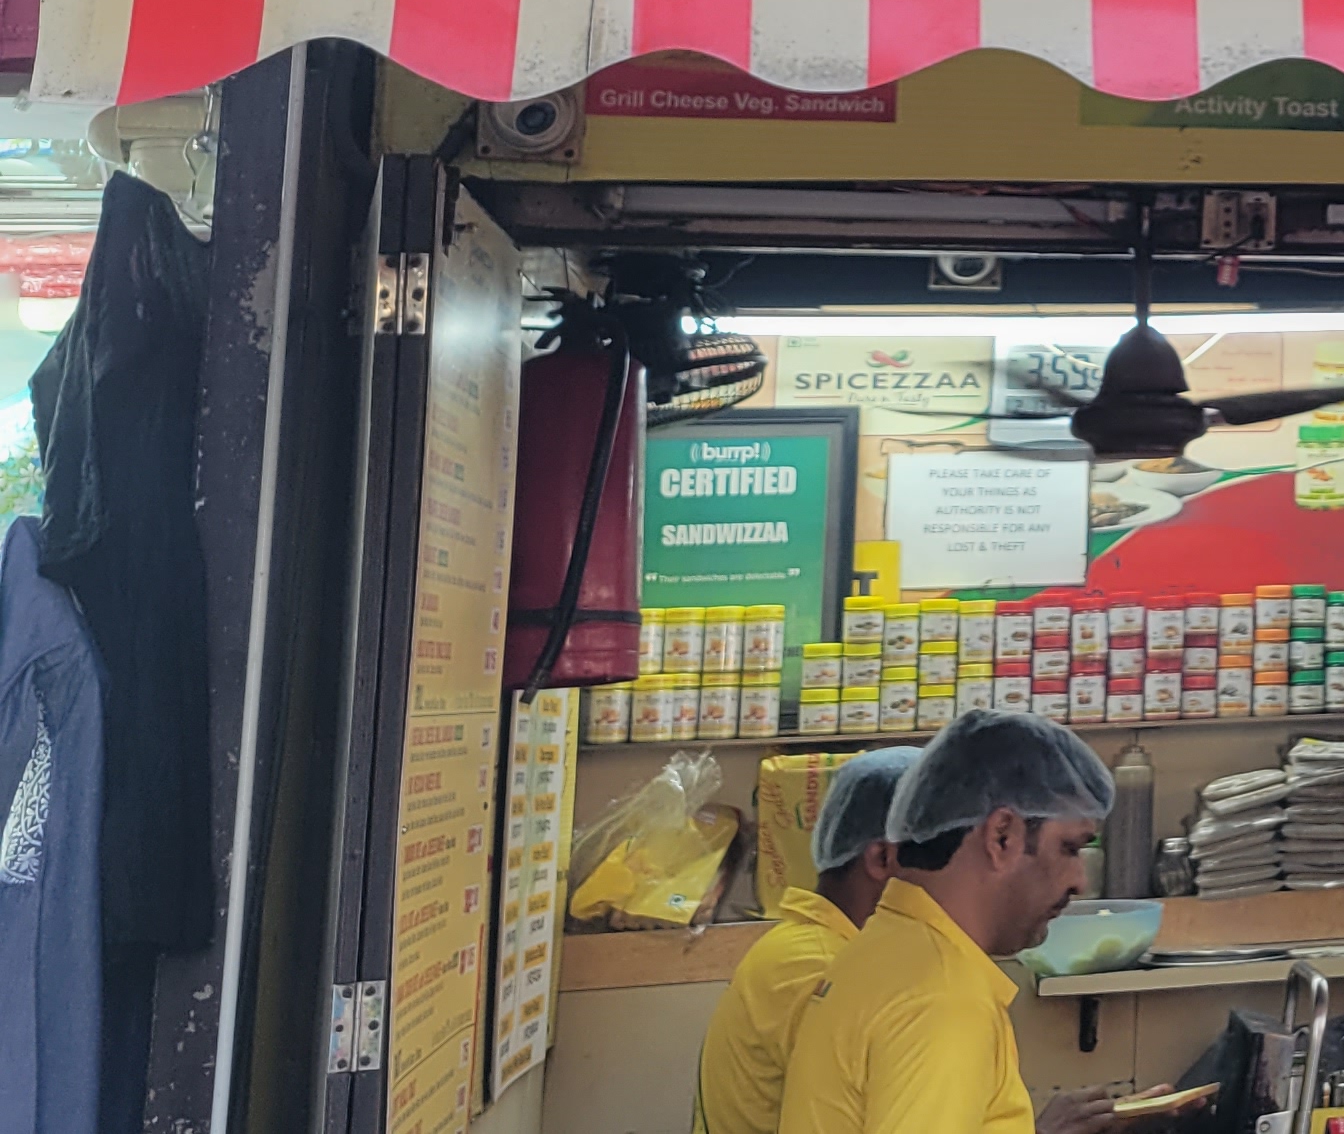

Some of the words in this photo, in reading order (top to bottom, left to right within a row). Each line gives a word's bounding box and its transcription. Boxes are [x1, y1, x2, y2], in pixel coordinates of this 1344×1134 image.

[600, 89, 643, 109] Grill
[652, 90, 728, 110] Cheese
[733, 92, 779, 115] Veg.
[783, 91, 886, 114] Sandwich
[1175, 95, 1266, 121] Activity
[1274, 96, 1339, 118] Toast
[794, 371, 982, 390] SPICEZZAA
[929, 468, 969, 478] PLEASE
[973, 468, 1001, 478] TAKE
[1004, 468, 1032, 478] CARE
[1036, 468, 1052, 478] OF
[660, 466, 797, 497] CERTIFIED
[942, 486, 975, 497] YOUR
[978, 486, 1020, 496] THINGS
[1023, 486, 1037, 496] AS
[935, 505, 1001, 515] AUTHORITY
[1004, 505, 1014, 515] IS
[1017, 505, 1041, 515] NOT
[661, 522, 788, 546] SANDWIZZAA
[923, 523, 999, 533] RESPONSIBLE
[1002, 523, 1025, 533] FOR
[1028, 523, 1051, 533] ANY
[947, 541, 976, 552] LOST
[978, 541, 988, 552] &
[991, 541, 1026, 552] THEFT
